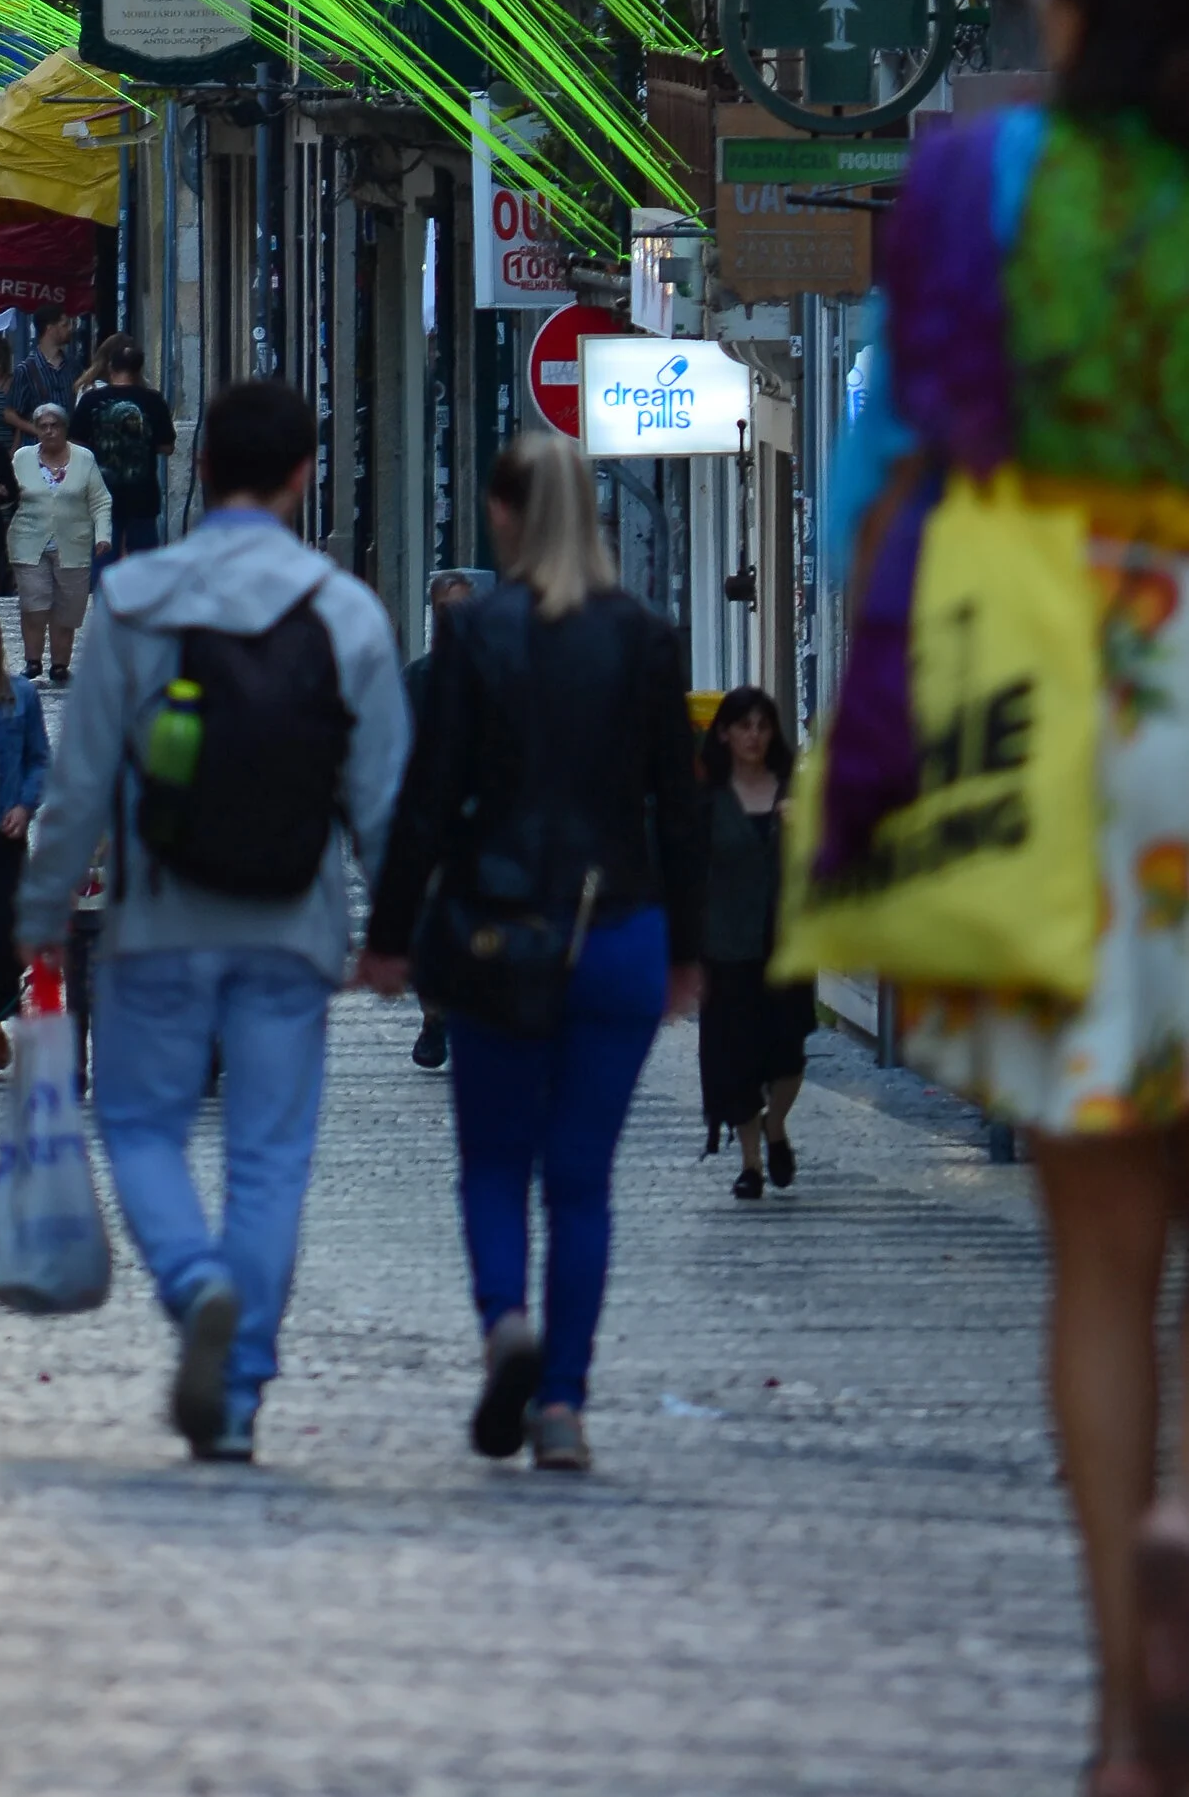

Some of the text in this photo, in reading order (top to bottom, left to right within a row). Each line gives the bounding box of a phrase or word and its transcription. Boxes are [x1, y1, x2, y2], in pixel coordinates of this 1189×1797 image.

[109, 26, 169, 37] DECORAÇÃO
[173, 27, 186, 36] DE
[603, 381, 695, 407] dream
[637, 405, 691, 436] pills
